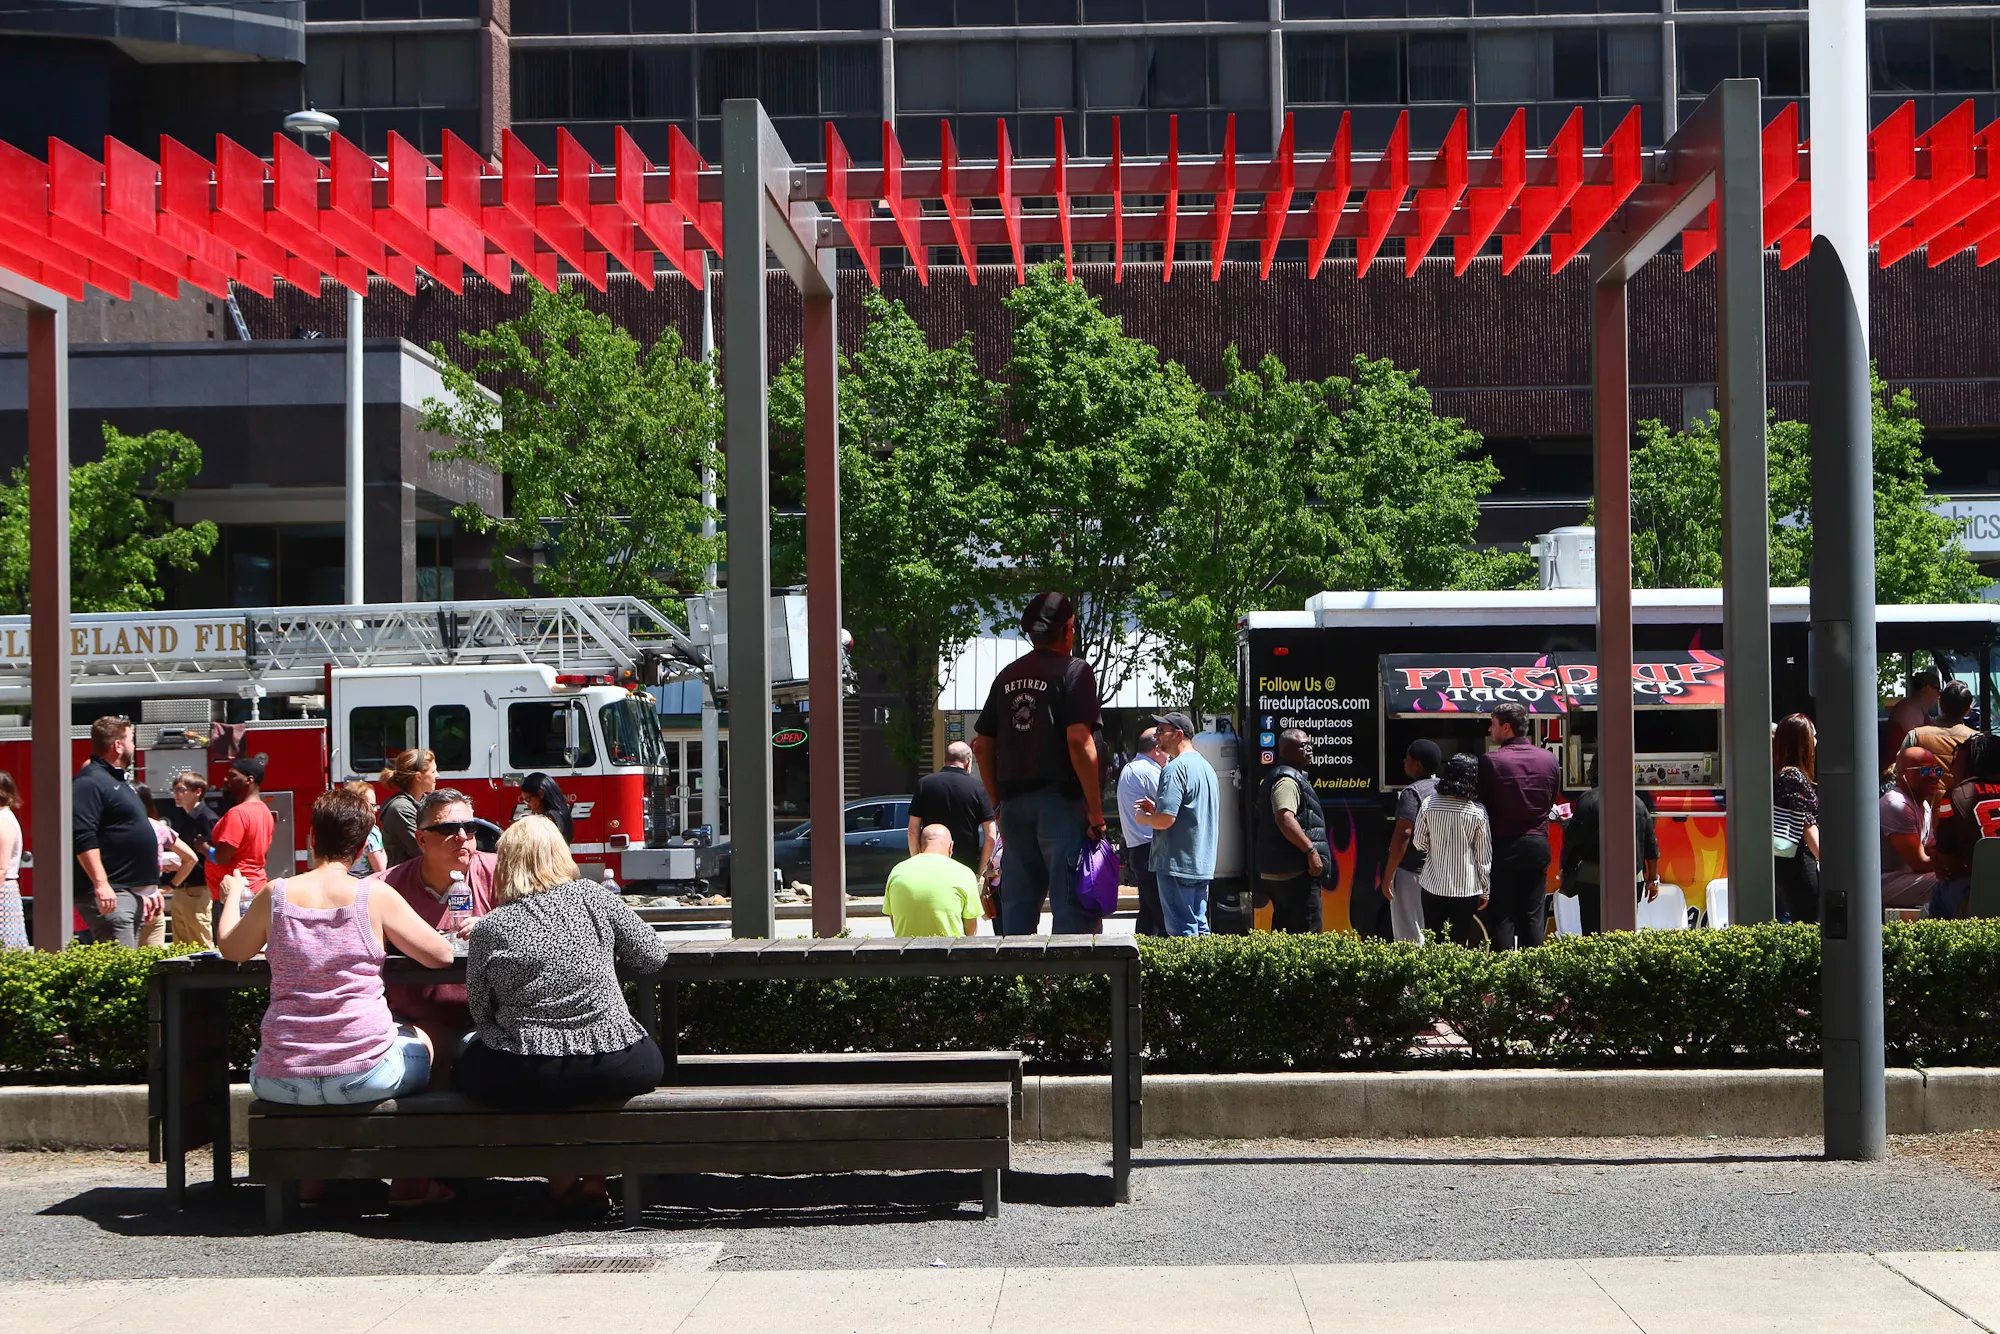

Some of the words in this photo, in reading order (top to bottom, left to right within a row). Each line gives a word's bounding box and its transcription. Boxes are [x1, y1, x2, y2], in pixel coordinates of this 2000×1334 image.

[1004, 679, 1047, 694] RETIRED
[1259, 677, 1301, 691] Follow
[1304, 677, 1321, 691] Us
[1325, 676, 1336, 691] @
[1446, 688, 1547, 702] TACO
[1259, 695, 1370, 713] fireduptacos.com
[1279, 717, 1353, 730] @fireduptacos
[775, 732, 803, 743] OPEN
[1313, 778, 1371, 788] Available!
